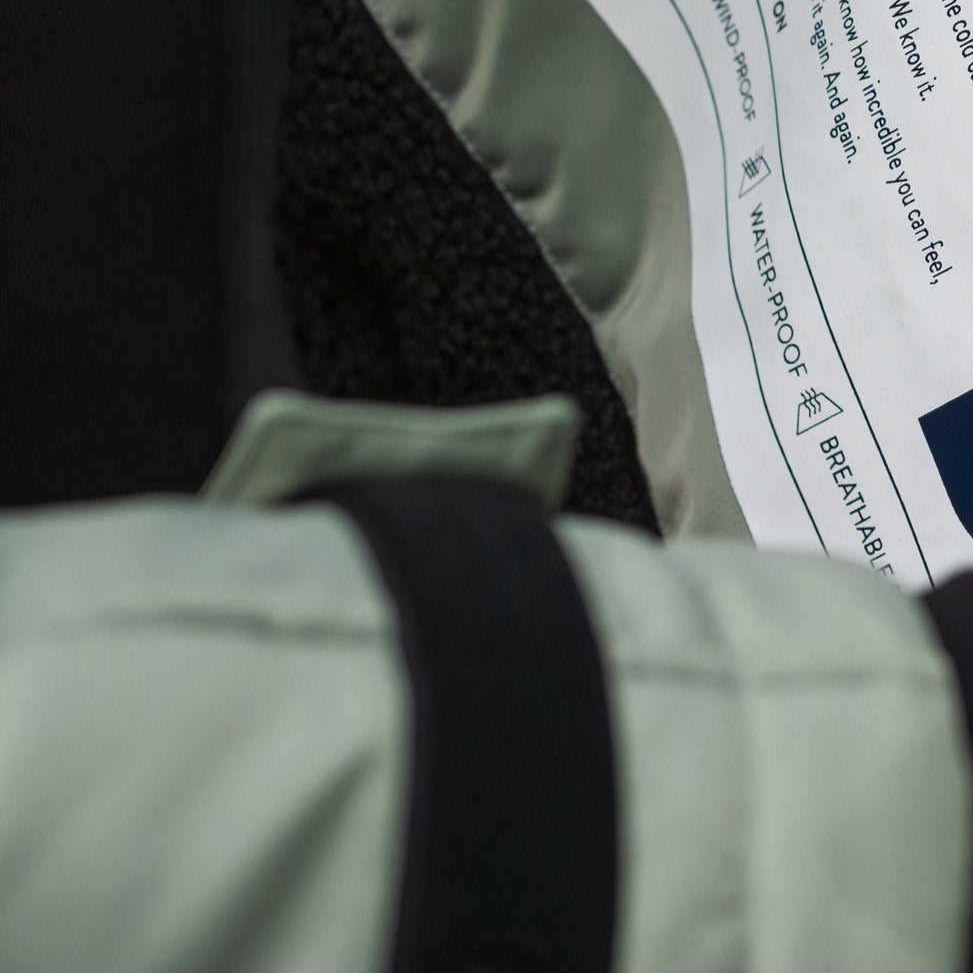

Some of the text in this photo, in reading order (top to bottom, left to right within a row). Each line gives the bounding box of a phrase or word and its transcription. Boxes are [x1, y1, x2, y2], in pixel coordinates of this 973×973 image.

[772, 0, 788, 33] ON
[810, 19, 834, 71] again.
[899, 27, 926, 78] know
[917, 76, 937, 102] it.
[823, 71, 849, 110] And
[829, 112, 861, 164] again.
[850, 40, 871, 81] how
[862, 79, 906, 170] incredible
[886, 170, 915, 207] you
[907, 209, 929, 242] can
[921, 240, 953, 285] feel,
[749, 202, 808, 377] WATER-PROOF
